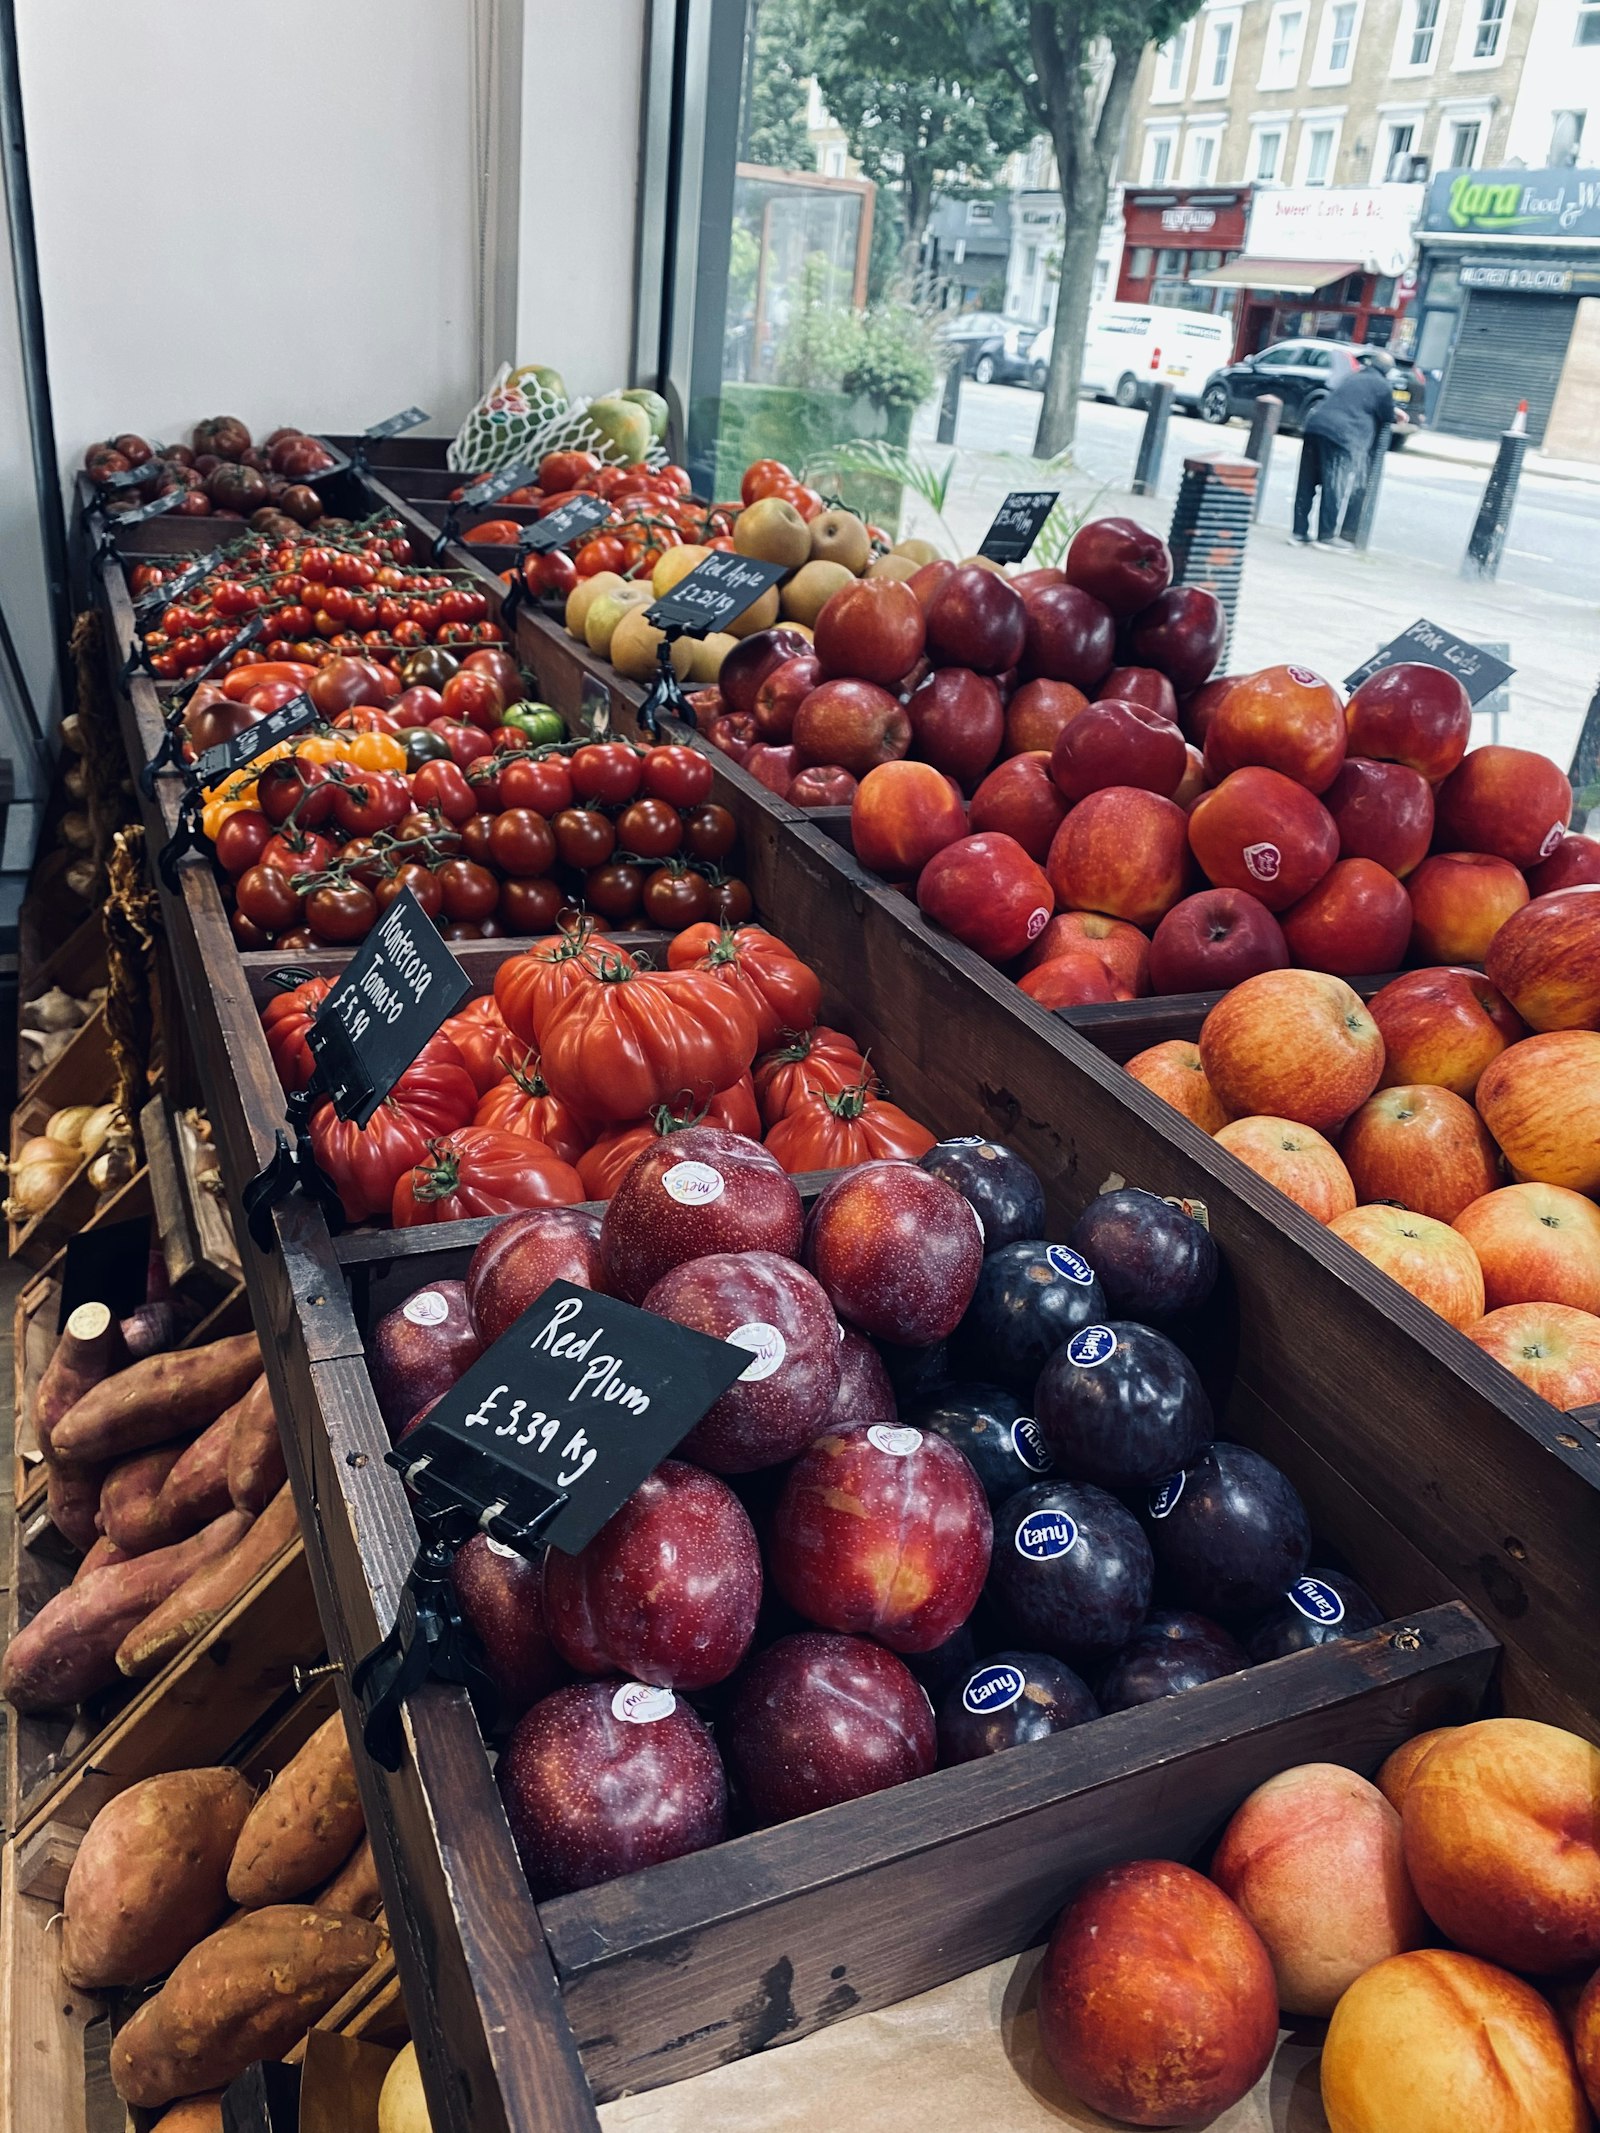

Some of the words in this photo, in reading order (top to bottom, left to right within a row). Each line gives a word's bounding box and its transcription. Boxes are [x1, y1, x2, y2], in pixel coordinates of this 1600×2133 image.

[1520, 186, 1565, 214] Food
[695, 555, 734, 577] Red
[721, 562, 765, 588] Apple
[1405, 620, 1446, 651] Pink
[1442, 644, 1483, 676] Lady
[360, 953, 403, 1024] Tomato
[332, 984, 371, 1042] £5.99
[1055, 1247, 1089, 1280] tany
[530, 1297, 603, 1362] Red
[568, 1355, 651, 1416] Plum
[1076, 1329, 1108, 1360] tany
[465, 1385, 560, 1453] £3.39
[1023, 1523, 1068, 1547] tany
[1298, 1581, 1335, 1618] tany
[968, 1673, 1017, 1705] tany
